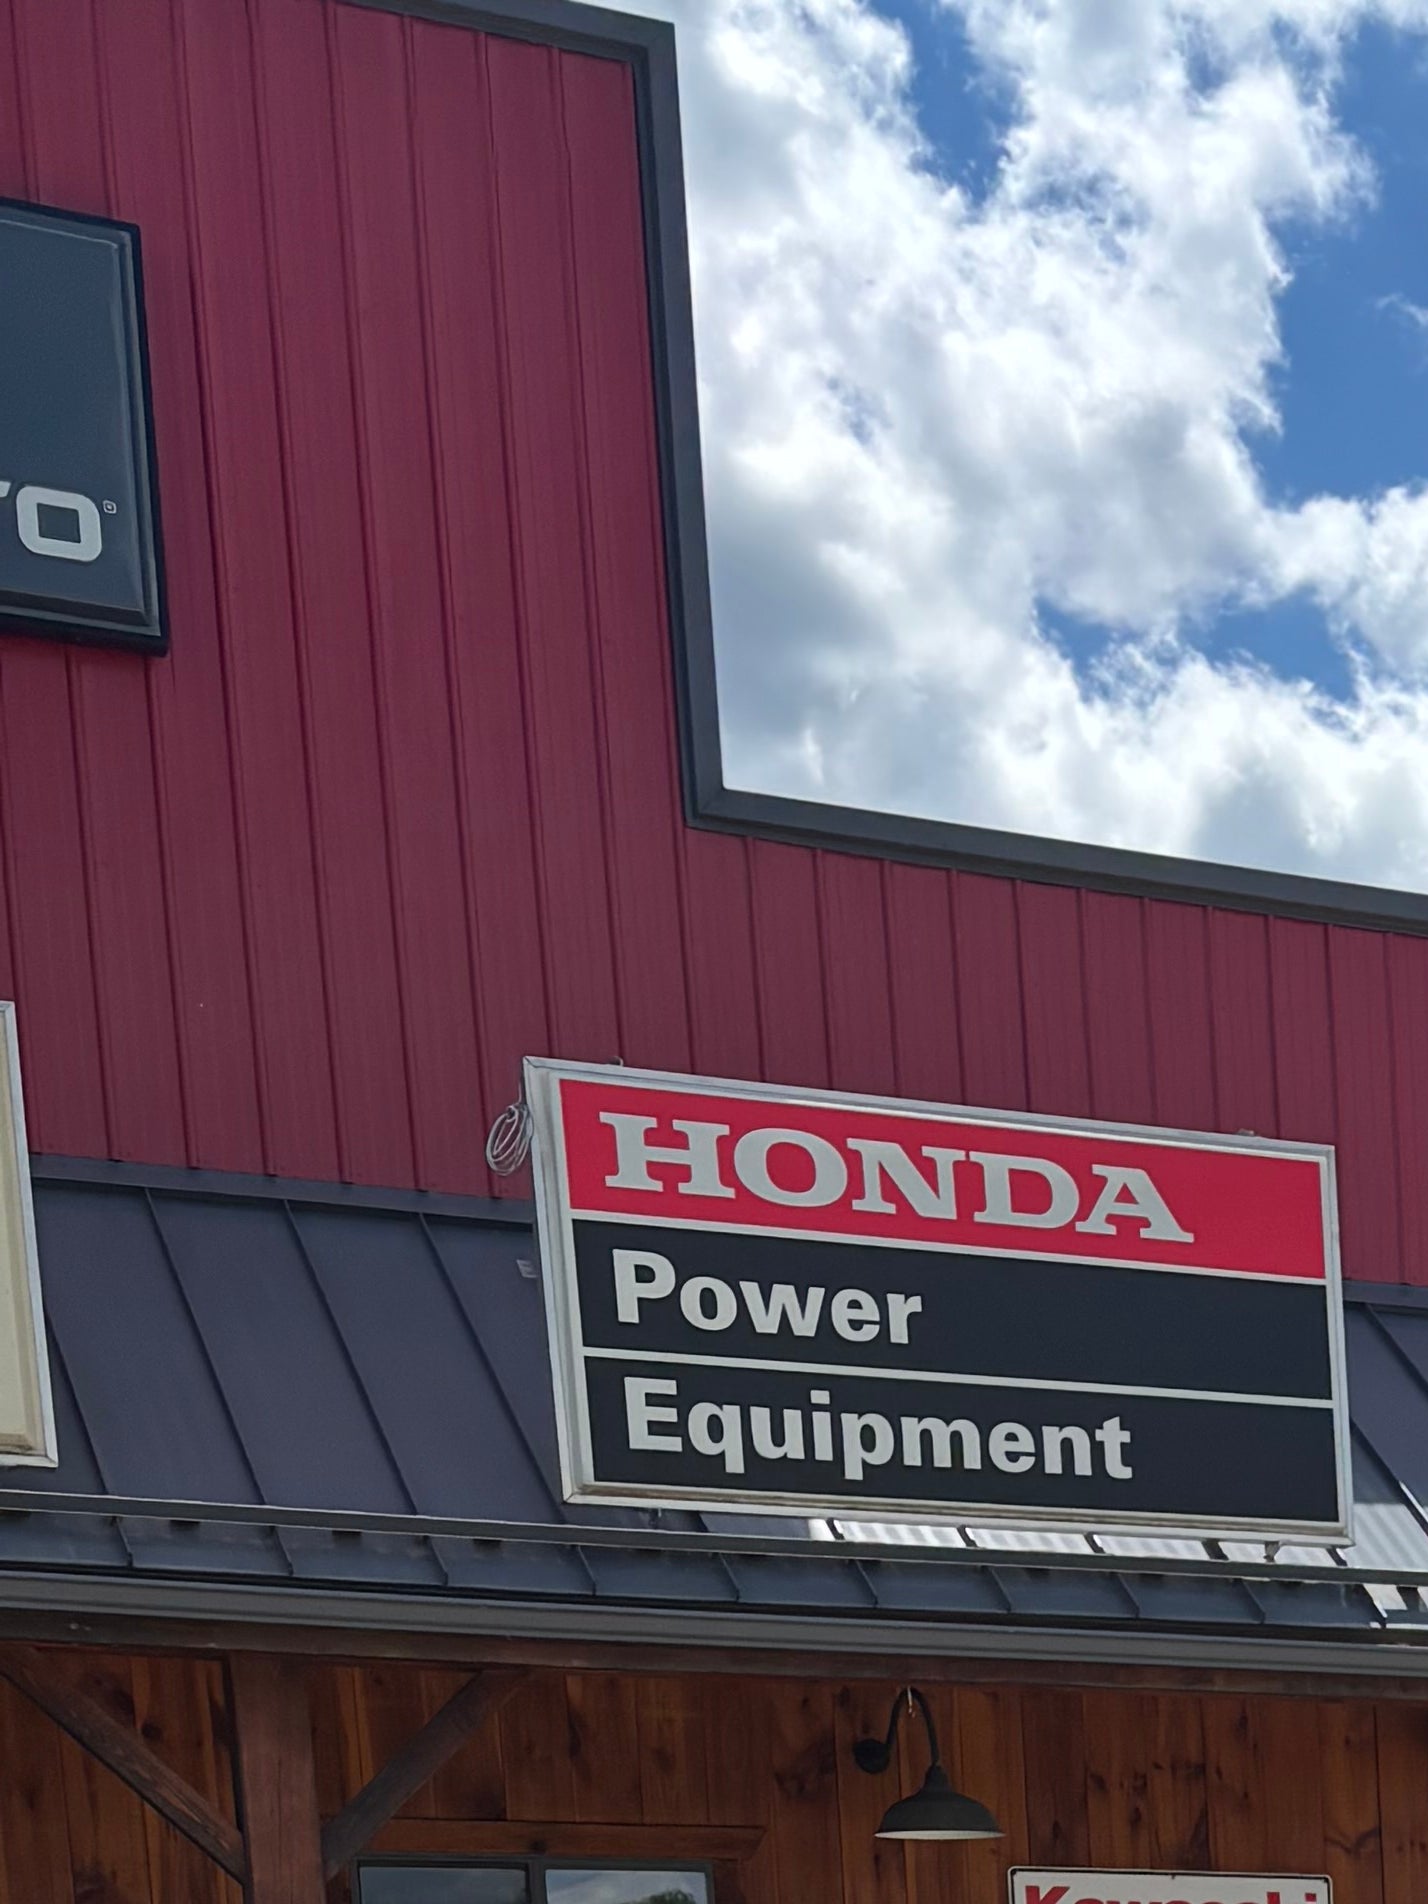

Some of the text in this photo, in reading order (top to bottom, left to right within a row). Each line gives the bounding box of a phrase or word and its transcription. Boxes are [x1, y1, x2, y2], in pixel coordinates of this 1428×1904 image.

[600, 1111, 1194, 1243] HONDA
[611, 1249, 922, 1344] Power
[624, 1376, 1133, 1480] Equipment
